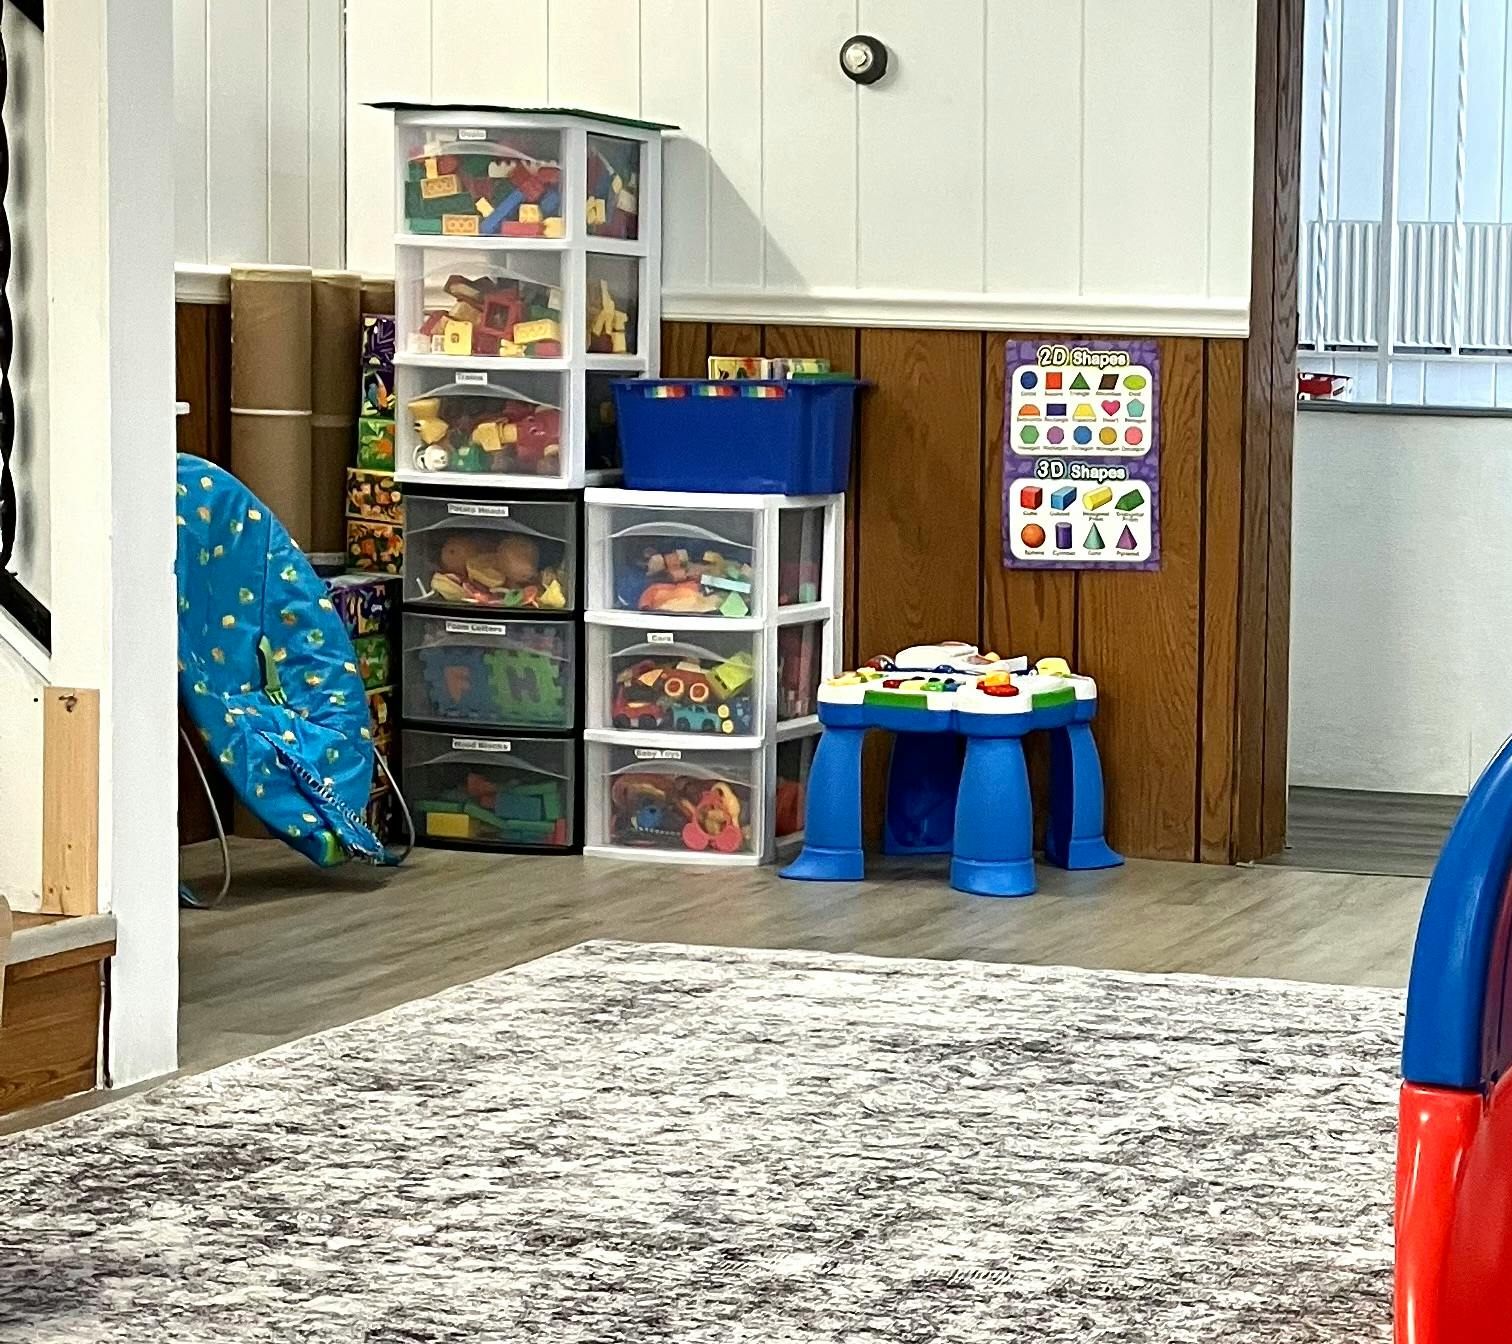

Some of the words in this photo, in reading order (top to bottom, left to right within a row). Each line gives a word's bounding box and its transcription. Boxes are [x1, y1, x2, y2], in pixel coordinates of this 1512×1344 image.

[1038, 347, 1068, 367] 2D
[1071, 348, 1128, 370] Shapes
[1036, 459, 1065, 480] 3D
[1069, 464, 1127, 484] Shapes
